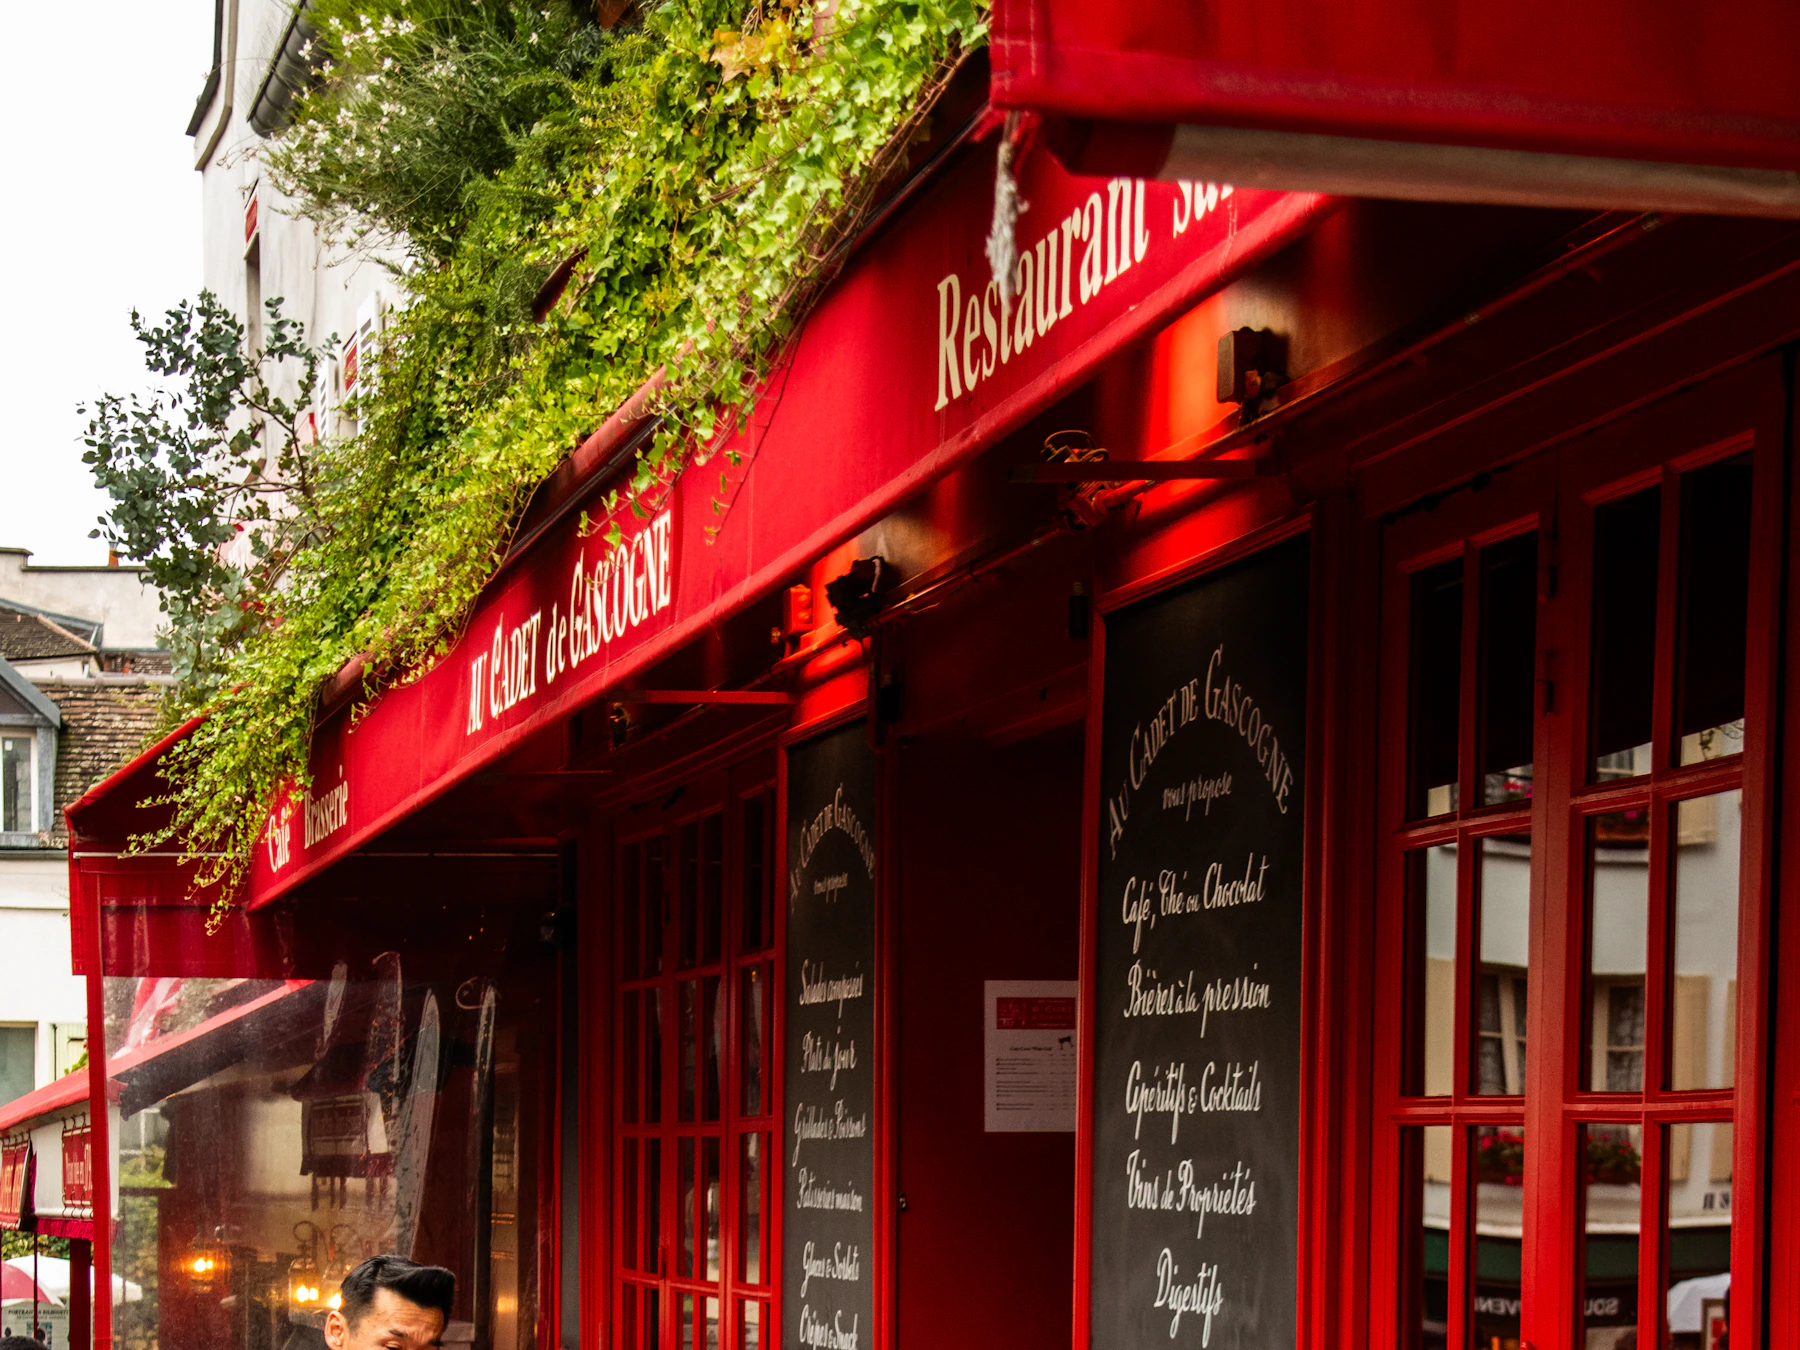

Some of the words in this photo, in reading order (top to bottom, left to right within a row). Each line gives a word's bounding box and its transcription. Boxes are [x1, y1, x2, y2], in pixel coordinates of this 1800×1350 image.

[934, 177, 1150, 412] Restaurant
[467, 650, 488, 736] AU
[490, 609, 542, 719] CADET
[546, 600, 567, 685] de
[569, 511, 673, 669] GASCOGNE
[1130, 688, 1177, 791] CADET
[1180, 678, 1199, 727] DE
[1204, 643, 1294, 815] GASCOGNE
[268, 802, 291, 873] Café
[304, 764, 349, 850] Brasserie
[1162, 781, 1186, 810] vous
[1185, 770, 1233, 822] propose
[1122, 875, 1157, 955] Café,
[1158, 869, 1188, 917] Thé
[1186, 893, 1201, 914] ou
[1203, 852, 1271, 910] Chocolat
[799, 958, 828, 1006] Salades
[1123, 958, 1175, 1018] Bières
[1174, 979, 1185, 1014] à
[1185, 970, 1200, 1013] la
[1200, 962, 1272, 1039] pression
[801, 1031, 823, 1074] Plats
[829, 1025, 858, 1092] jour
[792, 1102, 828, 1168] Grillades
[833, 1099, 867, 1139] Poissons
[1125, 1060, 1187, 1145] Apéritifs
[1187, 1086, 1198, 1115] &
[1200, 1059, 1262, 1113] Cocktails
[835, 1180, 863, 1212] maison
[1126, 1148, 1160, 1211] Vins
[1160, 1169, 1174, 1211] de
[1176, 1158, 1257, 1240] Propriétés
[800, 1240, 826, 1298] Glaces
[825, 1257, 833, 1279] &
[831, 1240, 860, 1282] Sorbets
[1153, 1247, 1224, 1349] Digestifs
